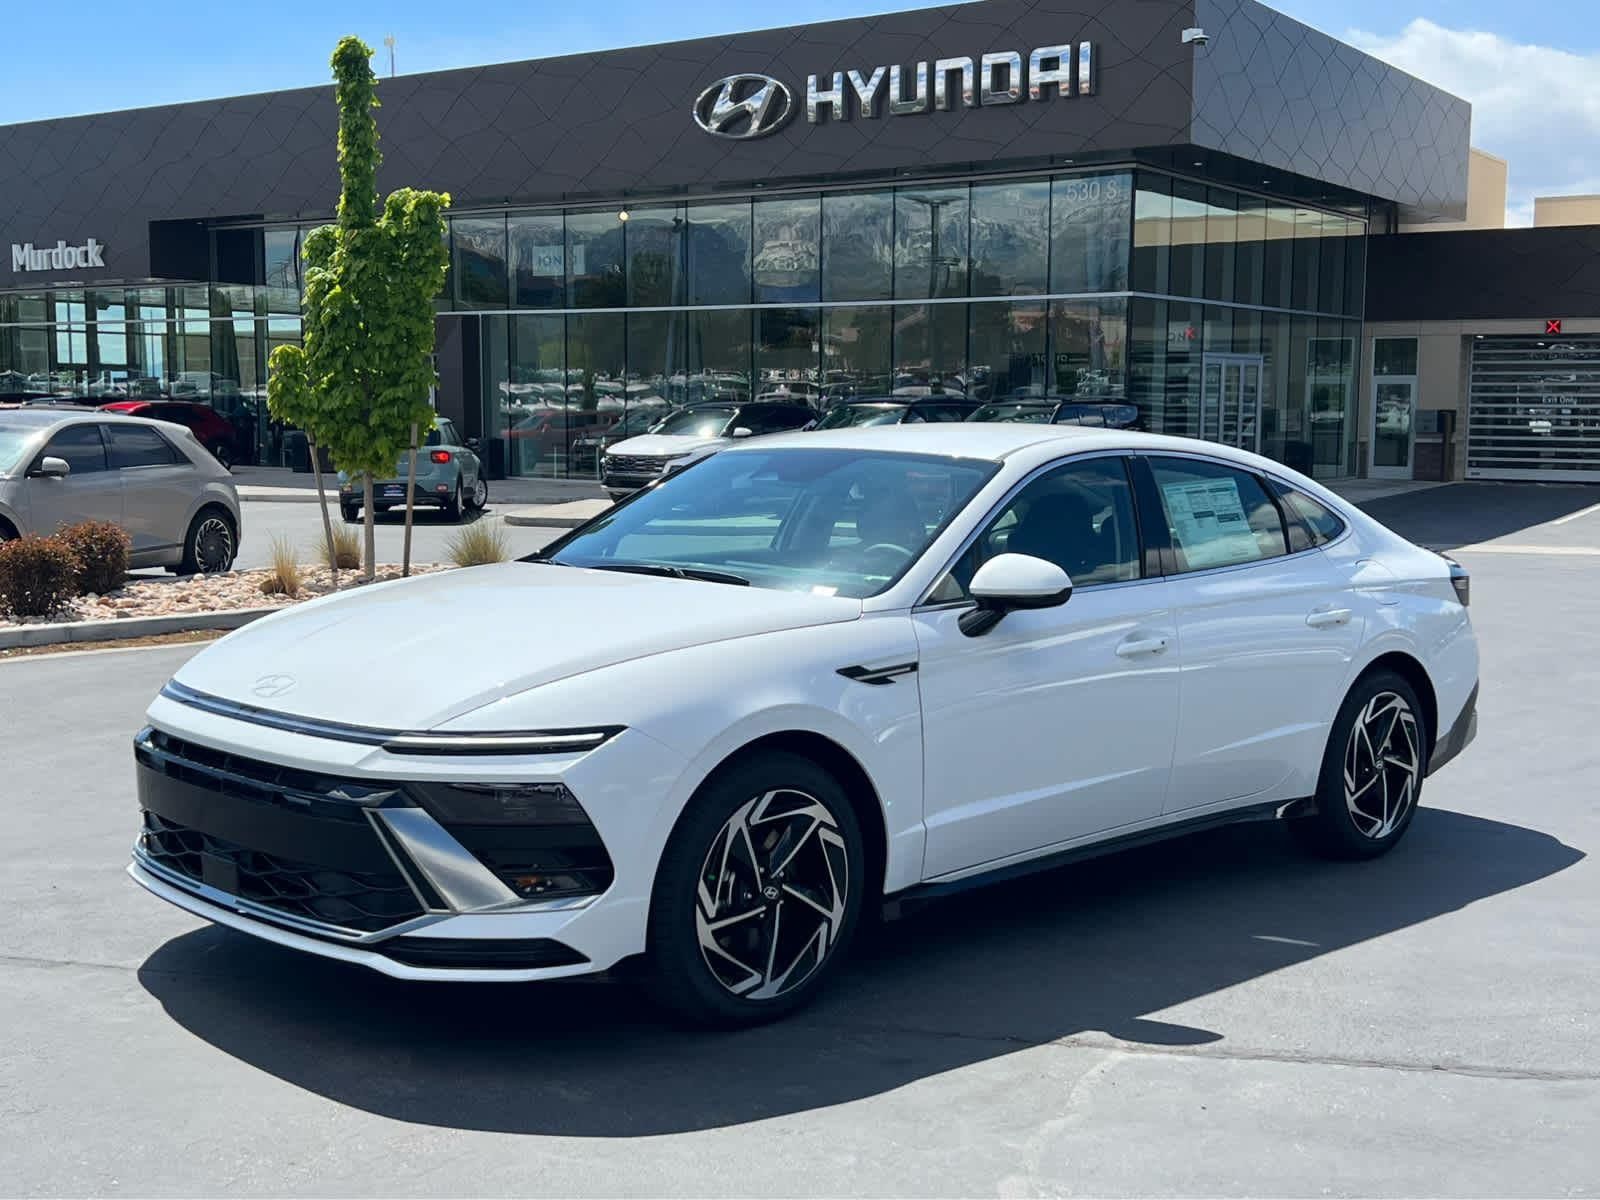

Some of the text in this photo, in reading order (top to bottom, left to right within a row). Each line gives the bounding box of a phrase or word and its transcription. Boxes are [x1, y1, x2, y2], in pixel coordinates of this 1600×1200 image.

[807, 41, 1093, 123] HYUNDAI
[1066, 181, 1100, 201] 530
[12, 238, 104, 272] Murdock
